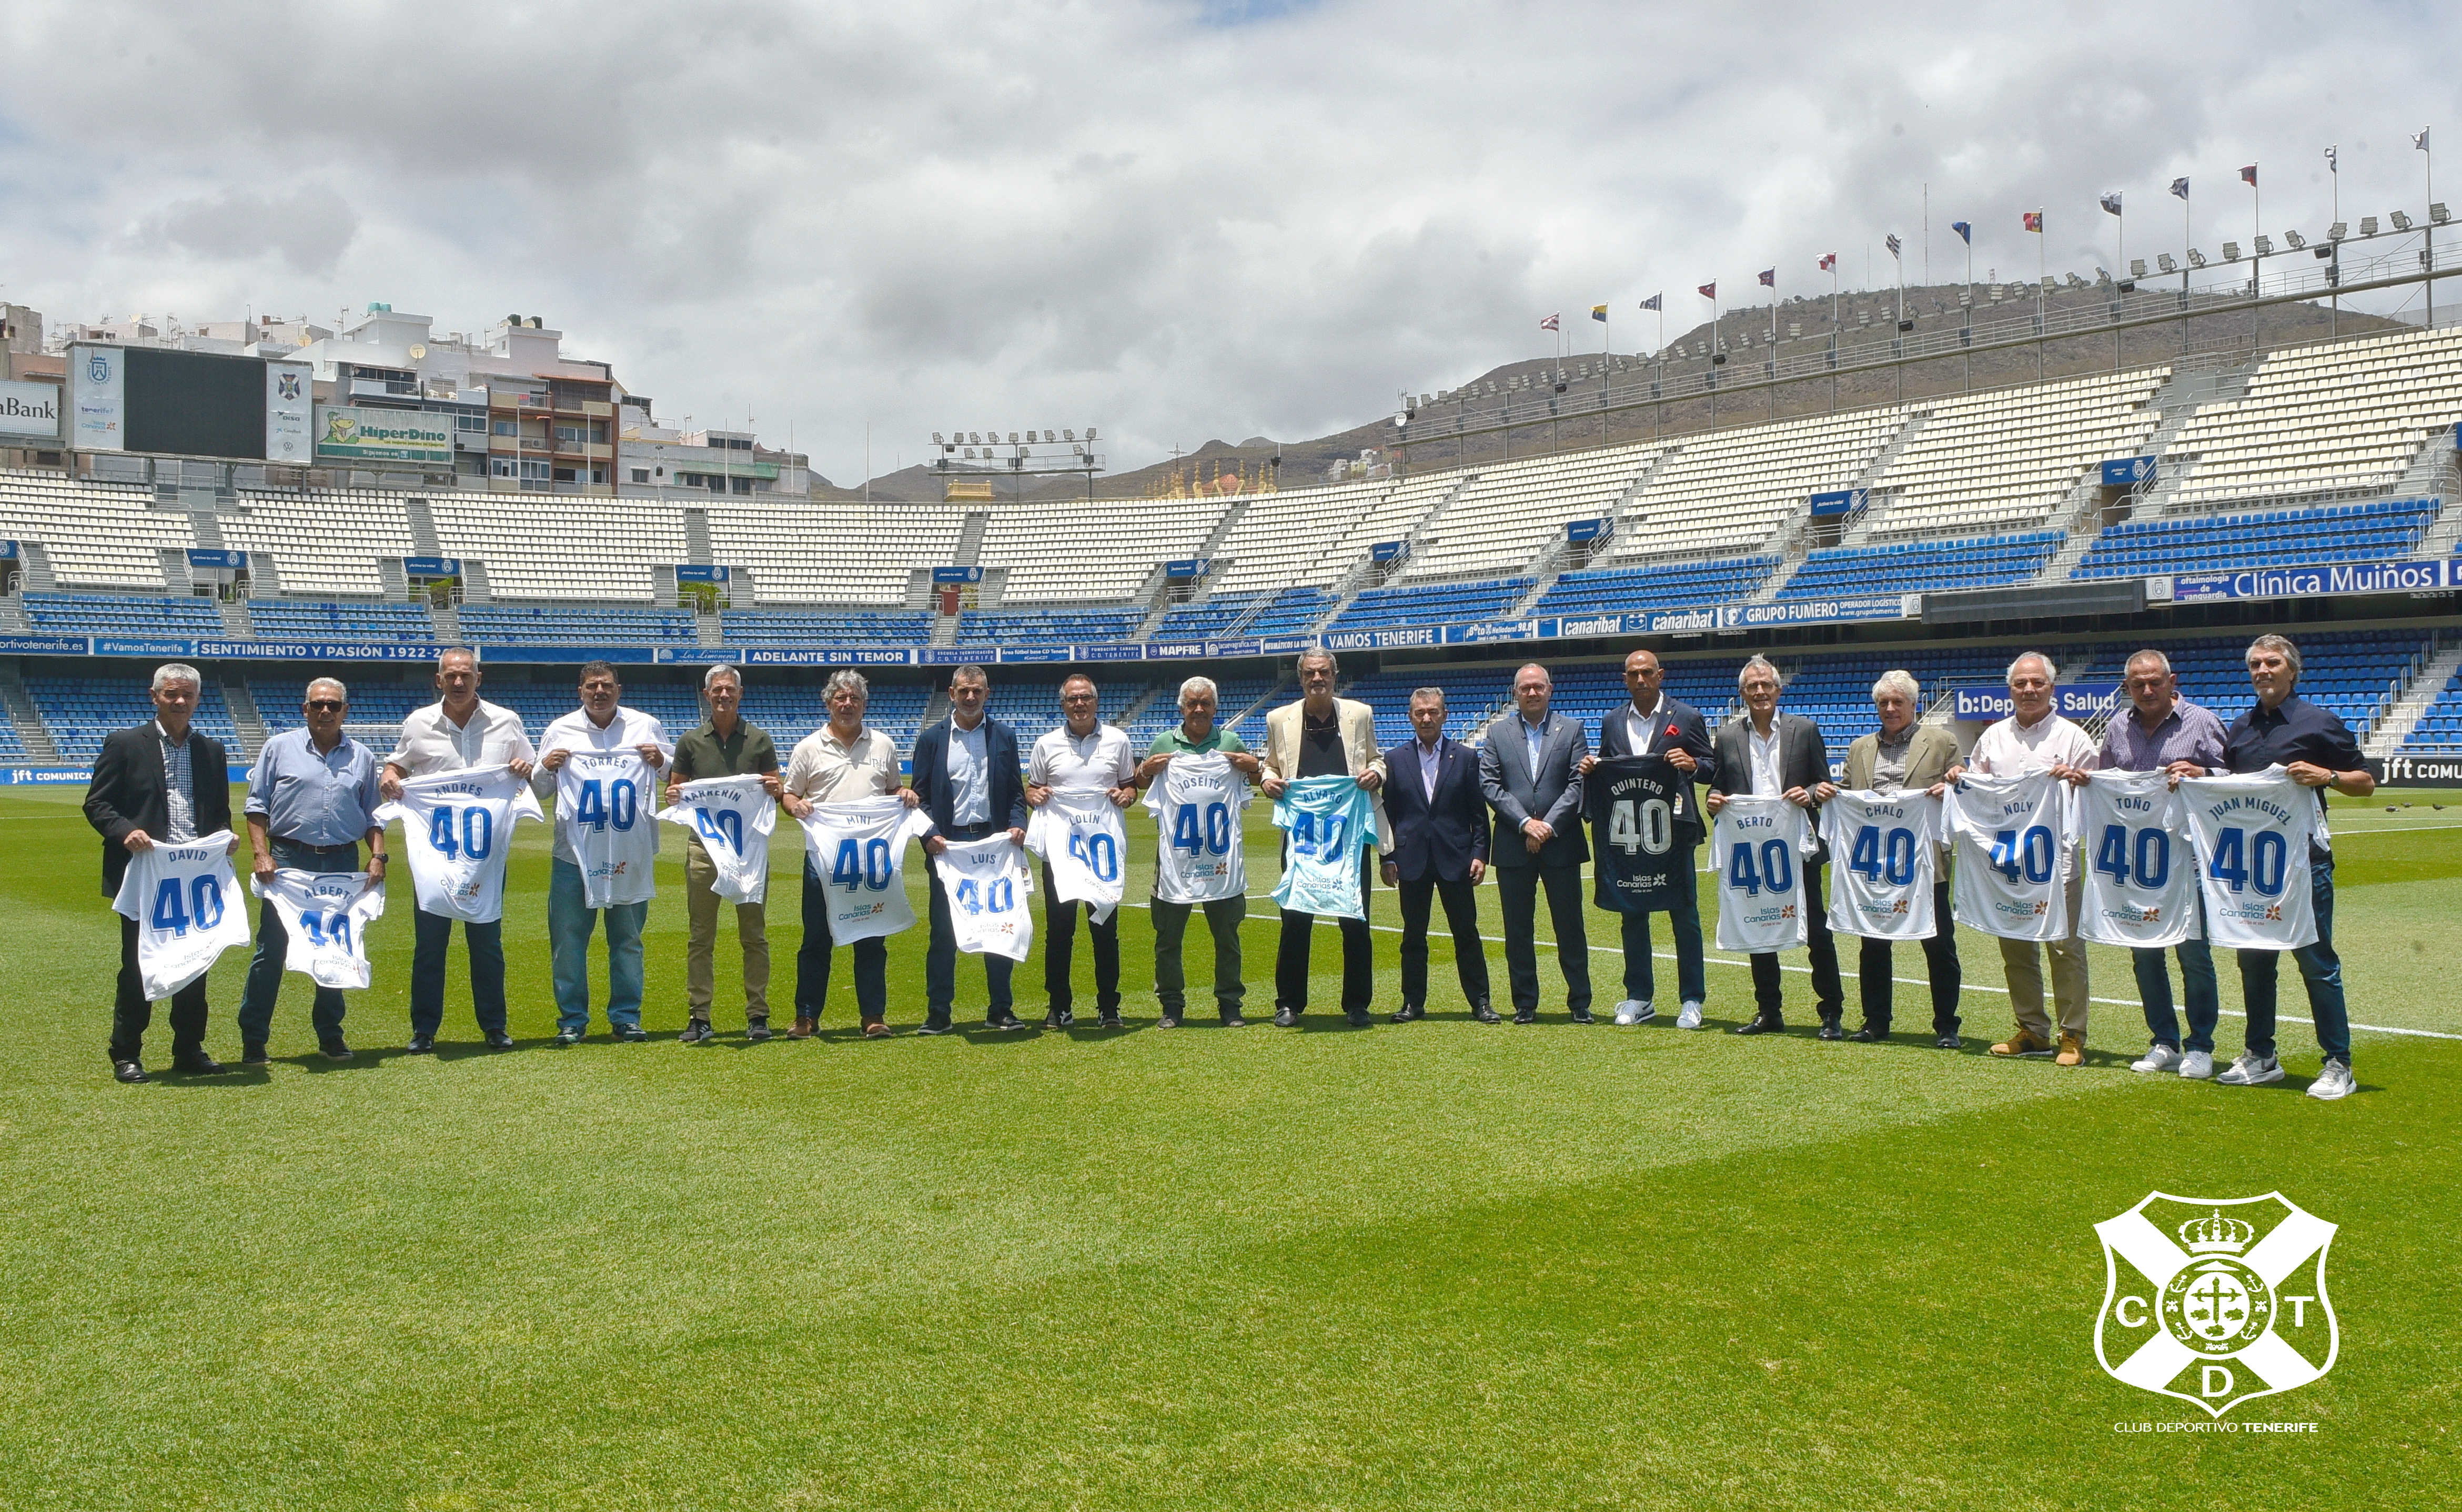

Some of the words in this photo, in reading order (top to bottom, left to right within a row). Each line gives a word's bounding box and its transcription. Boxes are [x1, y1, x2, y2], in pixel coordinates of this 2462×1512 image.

[360, 426, 446, 441] HiperDino
[2181, 574, 2229, 585] oftalmología
[2234, 570, 2320, 598] Clínica
[2329, 564, 2433, 592] Muiños
[2184, 590, 2227, 600] vanguardia
[1840, 600, 1871, 609] OPERADOR
[1872, 598, 1902, 607] LOGÍSTICO
[1747, 606, 1786, 622] GRUPO
[1789, 603, 1838, 619] FUMERO
[1840, 608, 1902, 617] www.grupofumero.es
[1518, 622, 1532, 632] 98.8
[1565, 616, 1621, 636] canaribat
[1652, 610, 1713, 631] canaribat
[1218, 640, 1260, 650] lacuevagrafica.com
[1265, 640, 1293, 650] NEUMÁTICOS
[1300, 639, 1316, 648] UNIÓN
[1328, 633, 1371, 649] VAMOS
[1374, 629, 1433, 646] TENERIFE
[103, 642, 184, 653] #VamosTenerife
[201, 643, 307, 657] SENTIMIENTO
[312, 646, 322, 657] Y
[327, 644, 382, 657] PASIÓN
[388, 647, 448, 658] 1922-2
[679, 650, 694, 659] Los
[697, 650, 736, 659] Limoneros
[1159, 645, 1202, 656] MAPFRE
[752, 652, 825, 662] ADELANTE
[829, 652, 852, 662] SIN
[856, 652, 904, 662] TEMOR
[2064, 692, 2115, 710] Salud
[582, 757, 629, 770] TORRES
[2380, 757, 2412, 784] jft
[13, 770, 32, 783] jft
[435, 783, 483, 798] ANDRÉS
[1177, 775, 1220, 794] JOSEÍTO
[1610, 778, 1663, 796] QUINTERO
[681, 788, 742, 804] MARRERÍN
[1303, 790, 1343, 804] ÁLVARO
[578, 779, 637, 833] 40
[2003, 801, 2034, 816] NOLY
[2115, 797, 2152, 812] TOÑO
[2209, 800, 2241, 822] JUAN
[2245, 795, 2291, 826] MIGUEL
[1865, 805, 1903, 819] CHALO
[846, 815, 871, 825] MINI
[1069, 813, 1100, 826] LOLÍN
[1737, 816, 1773, 830] BERTO
[695, 807, 743, 857] 40
[1172, 802, 1230, 858] 40
[1609, 799, 1672, 855] 40
[428, 806, 492, 863] 40
[1291, 812, 1347, 864] 40
[168, 849, 208, 862] DAVID
[971, 854, 996, 864] LUIS
[1067, 832, 1118, 883] 40
[1849, 825, 1915, 887] 40
[1987, 825, 2054, 885] 40
[2094, 824, 2170, 890] 40
[830, 838, 893, 893] 40
[1729, 839, 1792, 898] 40
[2207, 827, 2287, 898] 40
[1180, 870, 1215, 878] Canarias
[1617, 879, 1652, 888] Canarias
[304, 886, 354, 905] ALBERTO
[955, 876, 1014, 916] 40
[1872, 898, 1892, 906] Islas
[150, 874, 226, 940] 40
[1760, 906, 1780, 915] Islas
[1856, 903, 1892, 914] Canarias
[1995, 902, 2034, 915] Canarias
[2013, 900, 2034, 909] Islas
[2122, 904, 2142, 915] Islas
[2243, 902, 2265, 912] Islas
[839, 910, 871, 921] Canarias
[1743, 913, 1781, 924] Canarias
[2102, 909, 2142, 922] Canarias
[2219, 908, 2265, 919] Canarias
